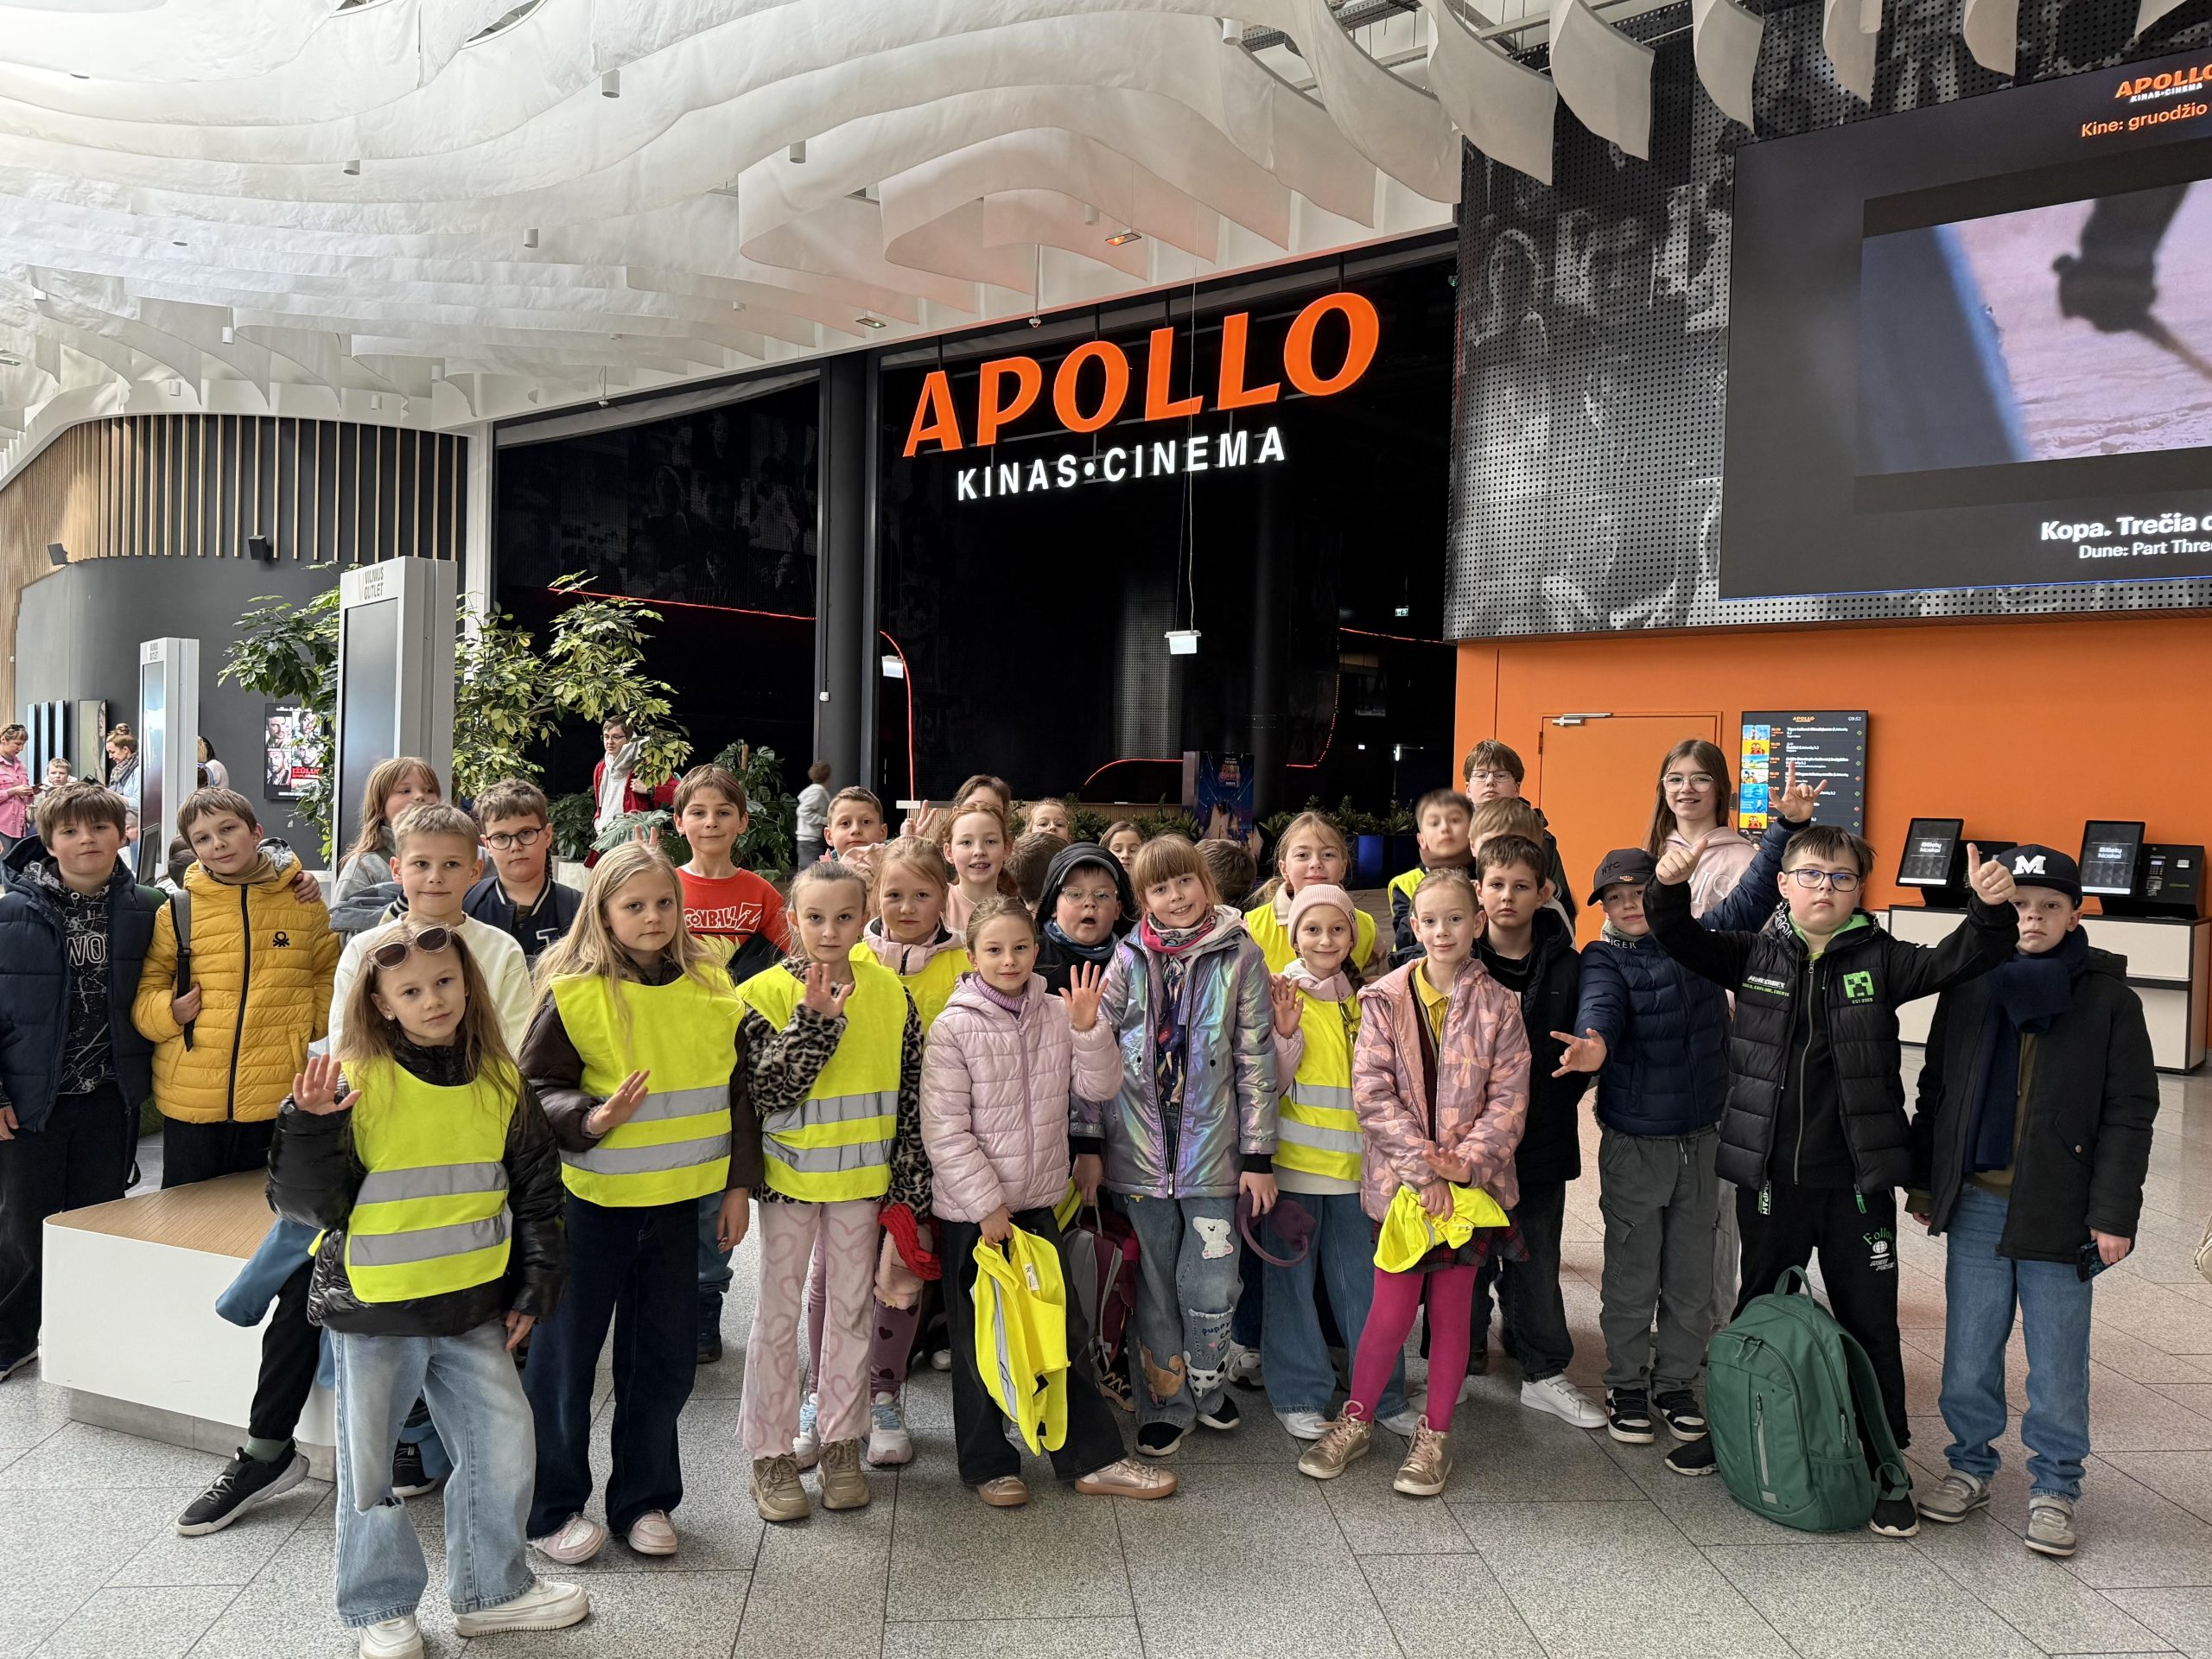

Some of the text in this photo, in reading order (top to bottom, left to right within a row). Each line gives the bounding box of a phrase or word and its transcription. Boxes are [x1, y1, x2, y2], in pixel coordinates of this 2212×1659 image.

[2082, 102, 2208, 137] Kine: gruodžio
[903, 291, 1380, 457] APOLLO
[2041, 520, 2113, 543] Kopa.
[2116, 512, 2197, 537] Trečia
[2078, 537, 2212, 559] Dune: Part Thre
[365, 566, 384, 585] VILNIUS
[364, 582, 384, 601] OUTLET
[1601, 861, 1621, 875] NYC
[2012, 855, 2046, 875] M
